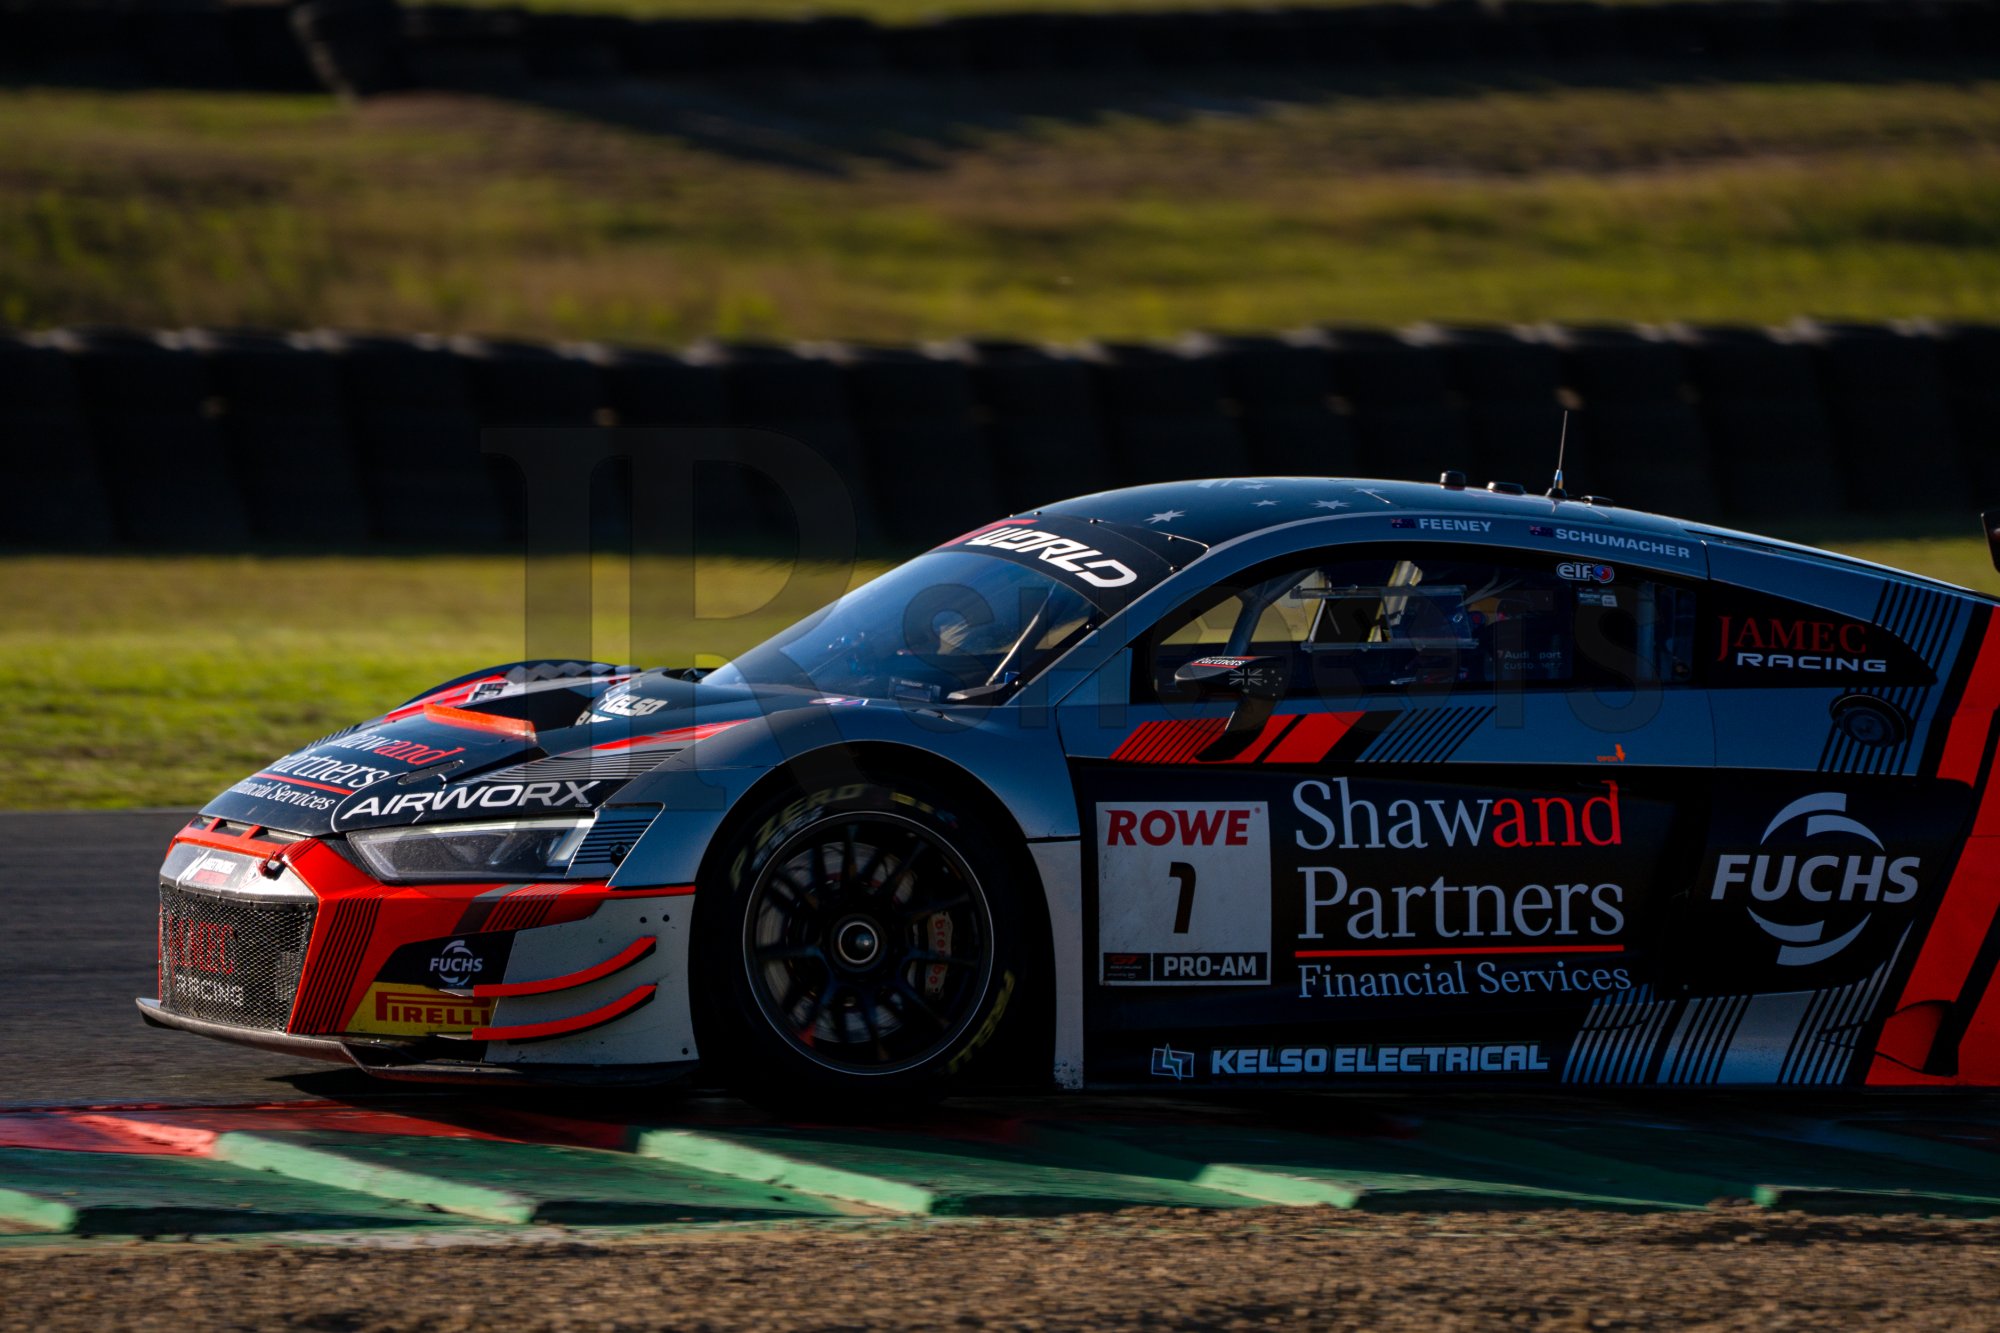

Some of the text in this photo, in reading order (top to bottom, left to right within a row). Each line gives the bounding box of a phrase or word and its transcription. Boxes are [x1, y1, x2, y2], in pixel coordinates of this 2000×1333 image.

[1418, 517, 1492, 533] FEENEY
[965, 526, 1138, 588] WORLD
[1555, 528, 1690, 560] SCHUMACHER
[1556, 562, 1595, 581] elf
[1716, 615, 1870, 661] JAMEC
[1736, 652, 1888, 673] RACING
[268, 783, 337, 811] Services
[341, 780, 601, 820] AIRWORX
[1105, 810, 1250, 846] ROWE
[1710, 853, 1921, 904] FUCHS
[1296, 865, 1625, 940] Partners
[429, 957, 484, 973] FUCHS
[1163, 955, 1258, 978] PRO-AM
[1297, 959, 1633, 999] Financial Services
[375, 991, 491, 1026] PIRELLI
[1210, 1044, 1550, 1075] KELSO ELECTRICAL
